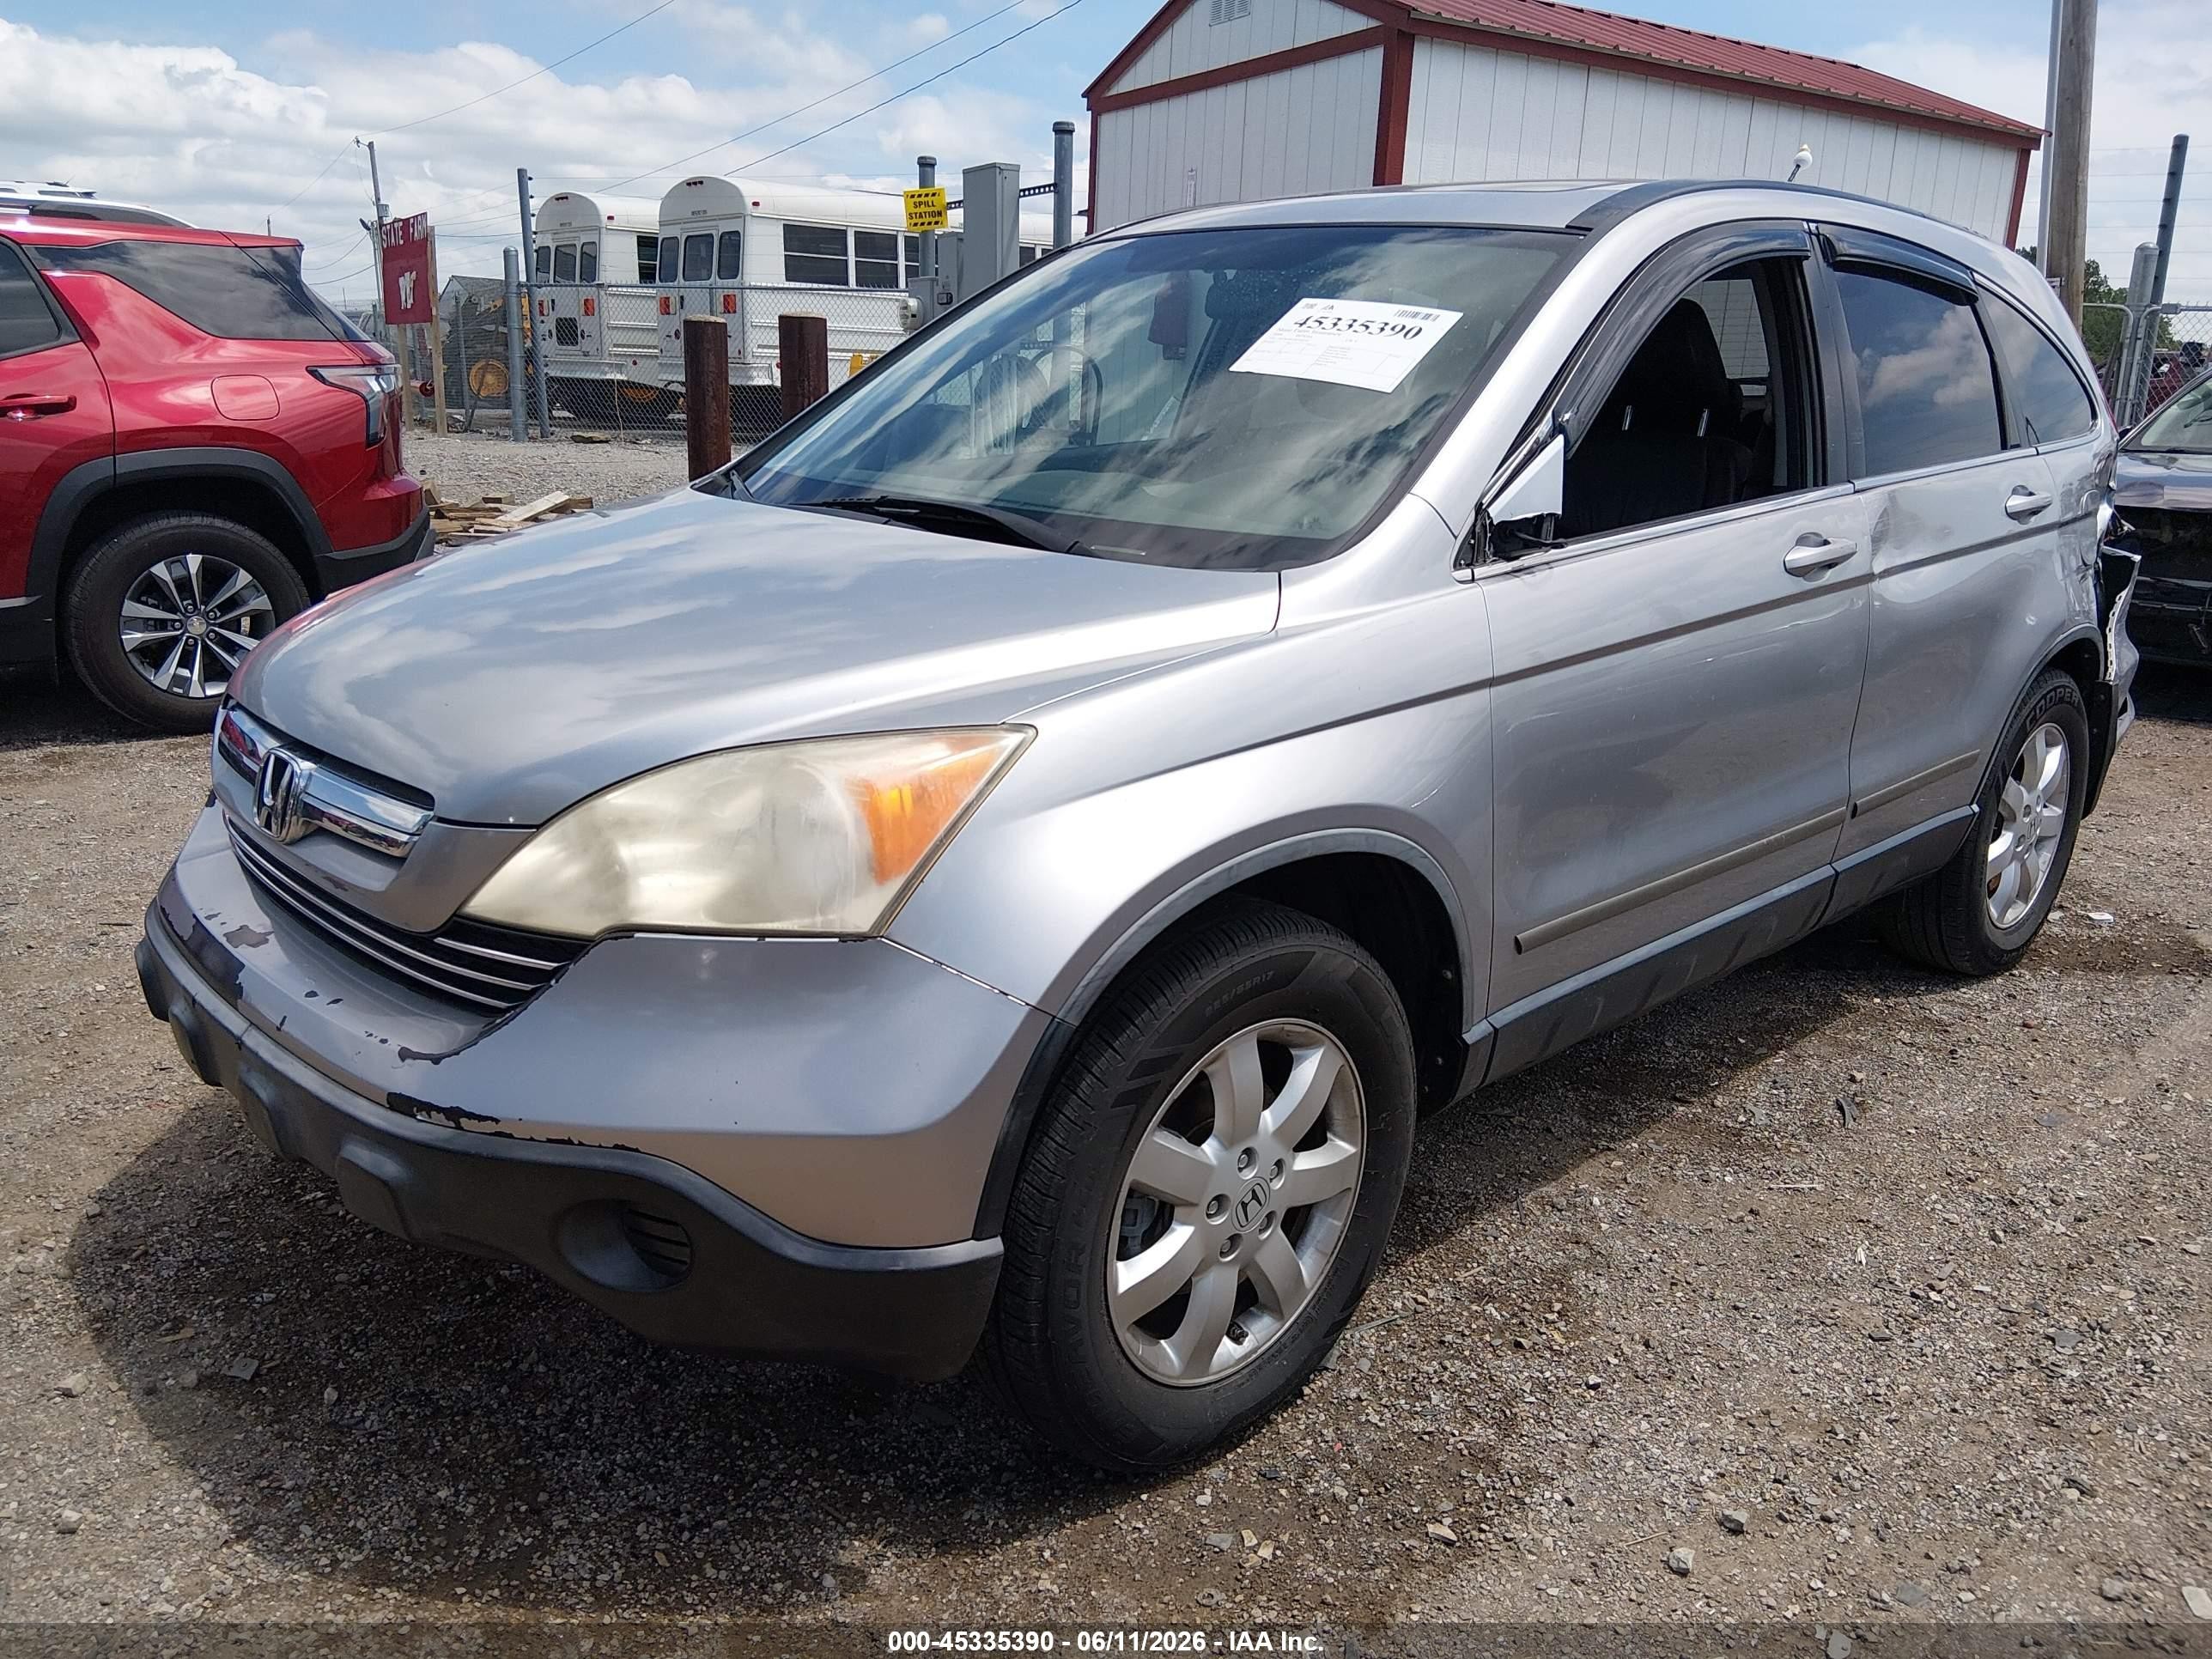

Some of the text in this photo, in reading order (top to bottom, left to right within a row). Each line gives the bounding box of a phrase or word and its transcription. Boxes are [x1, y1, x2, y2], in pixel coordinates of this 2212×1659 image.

[381, 213, 427, 248] STATE FARM
[908, 210, 943, 221] STATION
[1294, 315, 1423, 341] 45335390
[2026, 687, 2080, 732] COOPER
